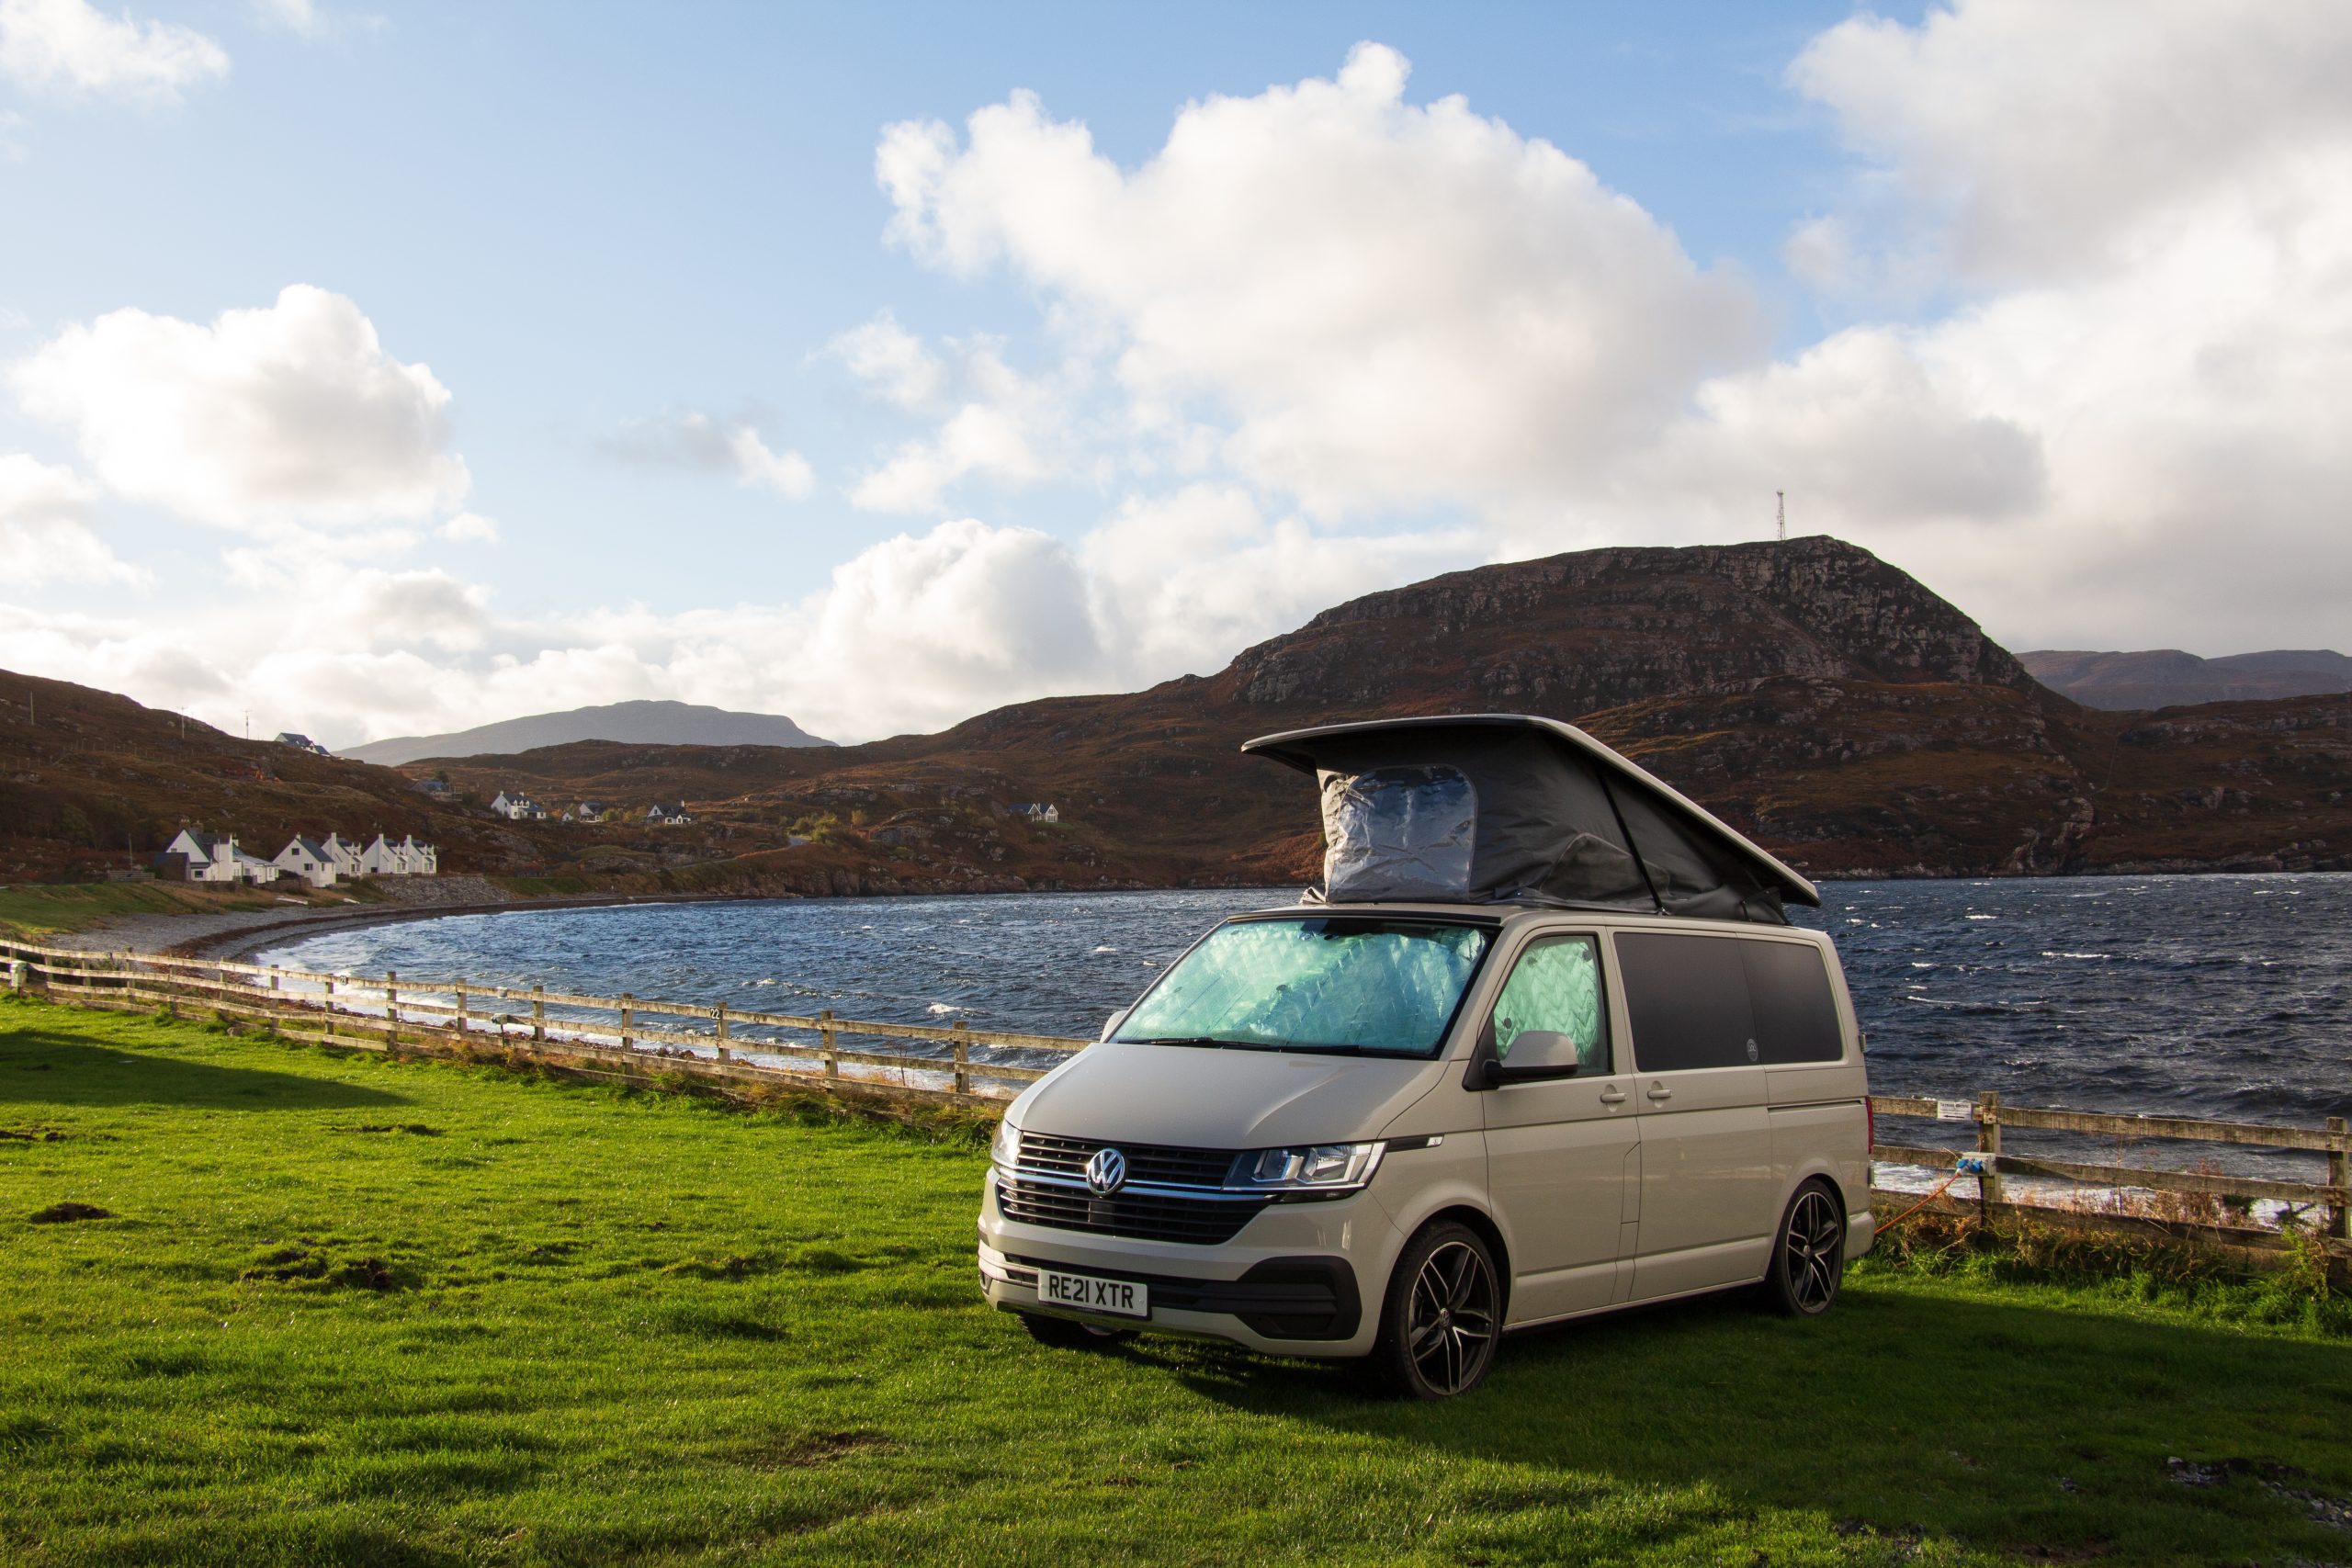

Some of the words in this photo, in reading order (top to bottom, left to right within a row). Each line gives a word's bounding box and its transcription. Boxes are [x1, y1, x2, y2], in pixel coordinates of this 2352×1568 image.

[710, 1008, 719, 1020] 22
[1049, 1275, 1089, 1303] RE21
[1095, 1281, 1133, 1309] XTR
